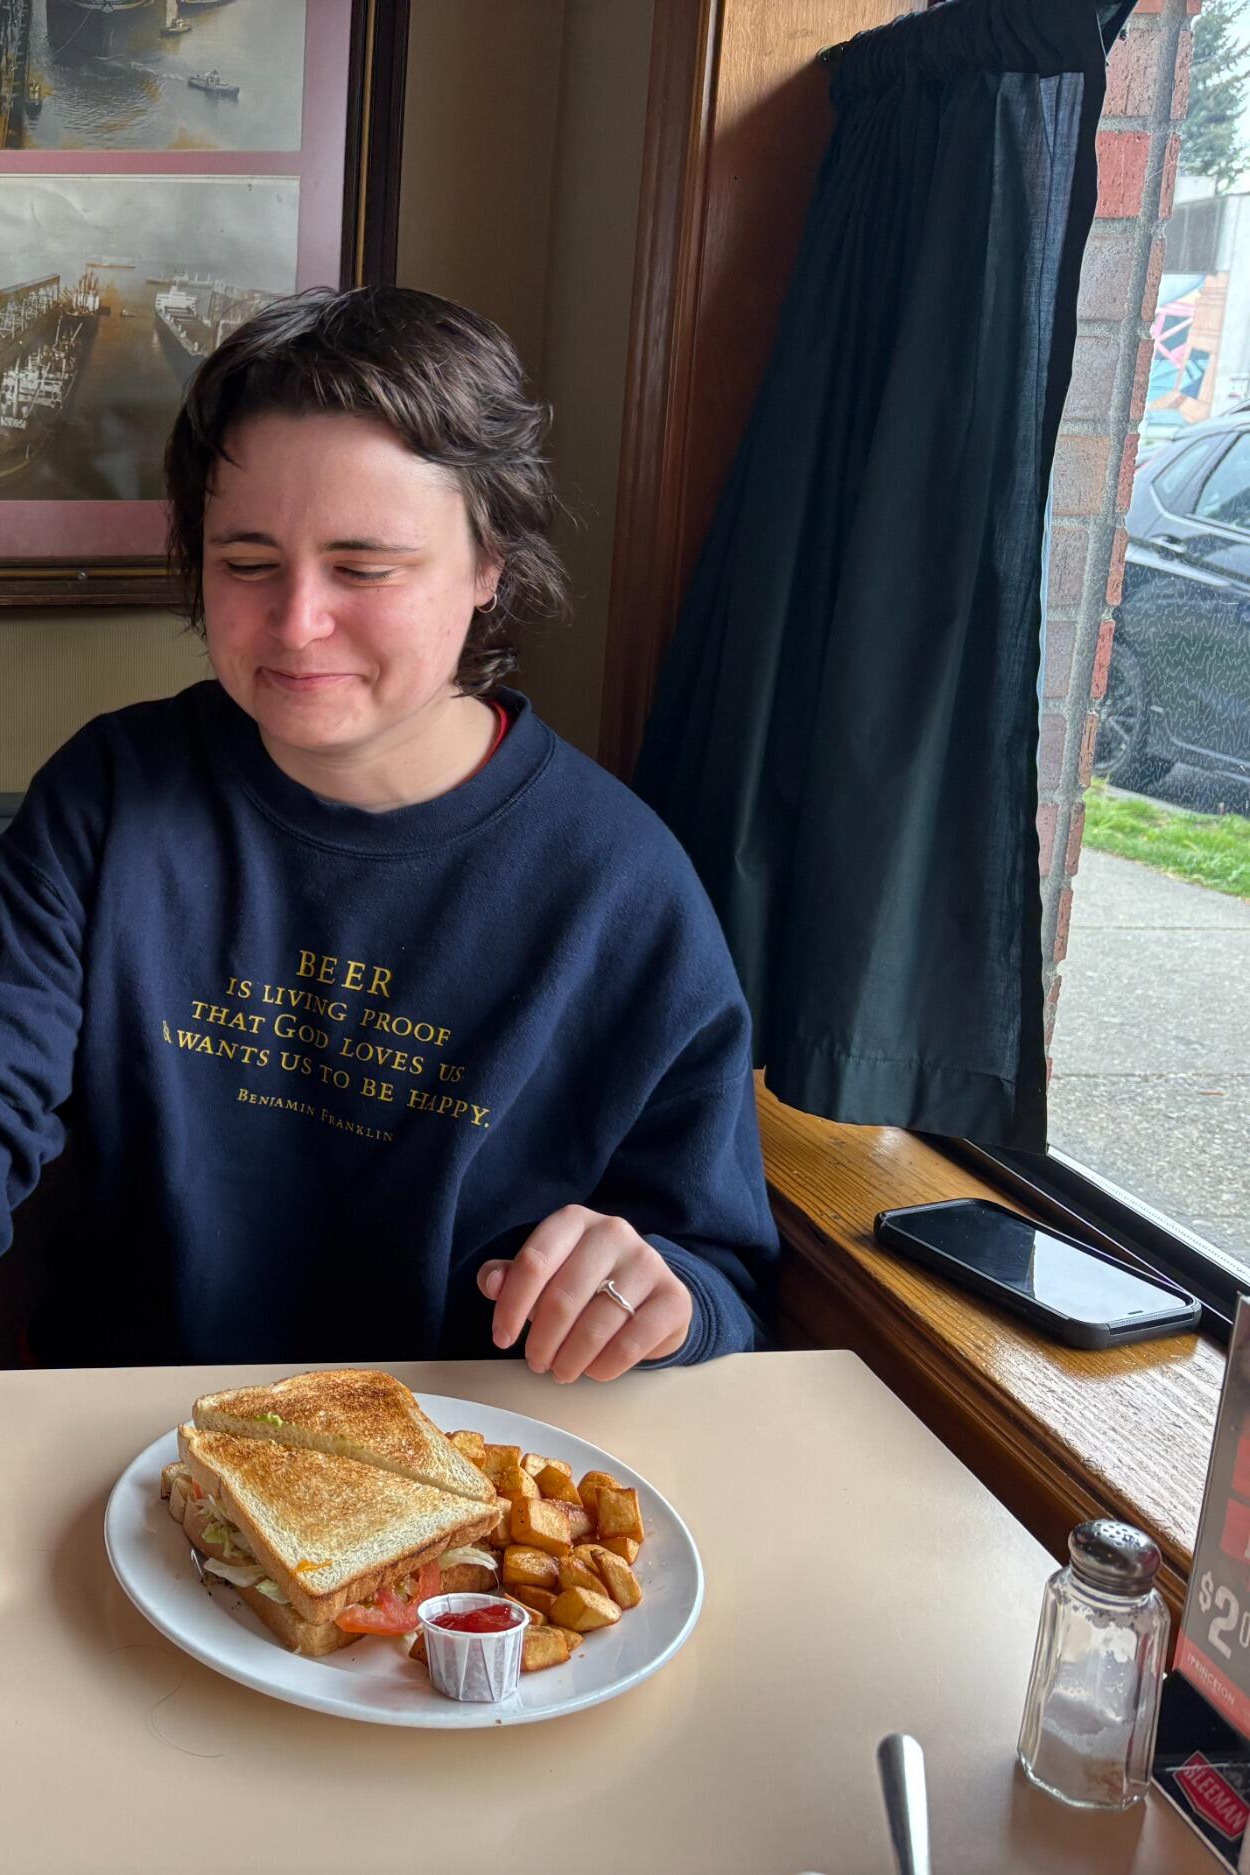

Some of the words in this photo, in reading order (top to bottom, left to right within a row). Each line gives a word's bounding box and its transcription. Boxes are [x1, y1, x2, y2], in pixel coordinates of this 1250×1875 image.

[296, 949, 393, 998] BEER
[192, 1000, 266, 1034] THAT
[339, 1038, 425, 1075] LOVES
[438, 1063, 466, 1083] US
[226, 977, 252, 999] IS
[262, 983, 348, 1022] LIVING
[360, 1008, 452, 1047] PROOF
[176, 1029, 271, 1067] WANTS
[279, 1051, 313, 1075] US
[319, 1064, 351, 1089] TO
[360, 1077, 395, 1102] BE
[406, 1088, 492, 1129] HAPPY.
[1183, 1764, 1246, 1829] SLEEMAN
